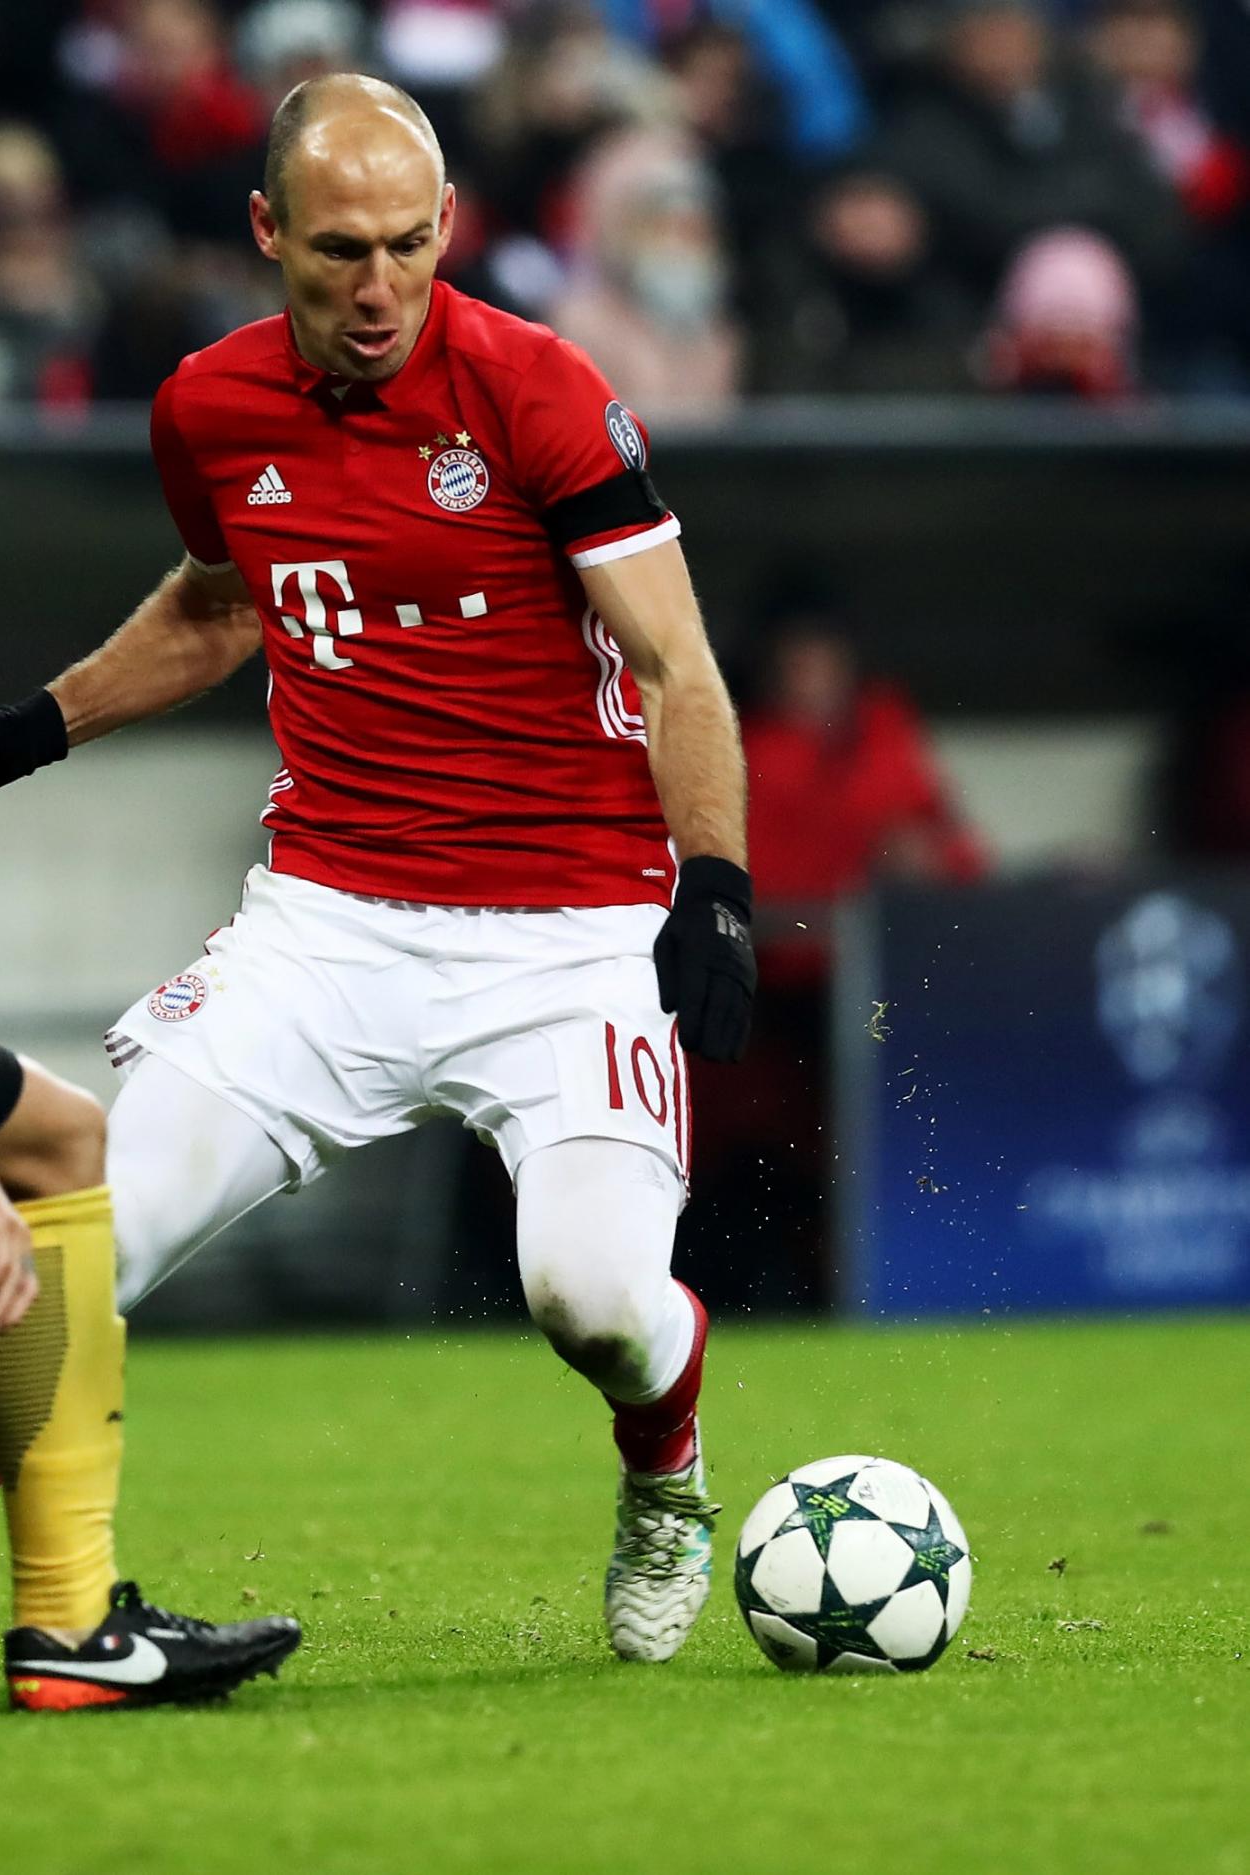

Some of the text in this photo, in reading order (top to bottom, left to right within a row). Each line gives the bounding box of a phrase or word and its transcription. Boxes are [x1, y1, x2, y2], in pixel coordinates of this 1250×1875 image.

[441, 452, 484, 475] BAYERN
[247, 490, 292, 505] adidas
[605, 1021, 667, 1127] 10
